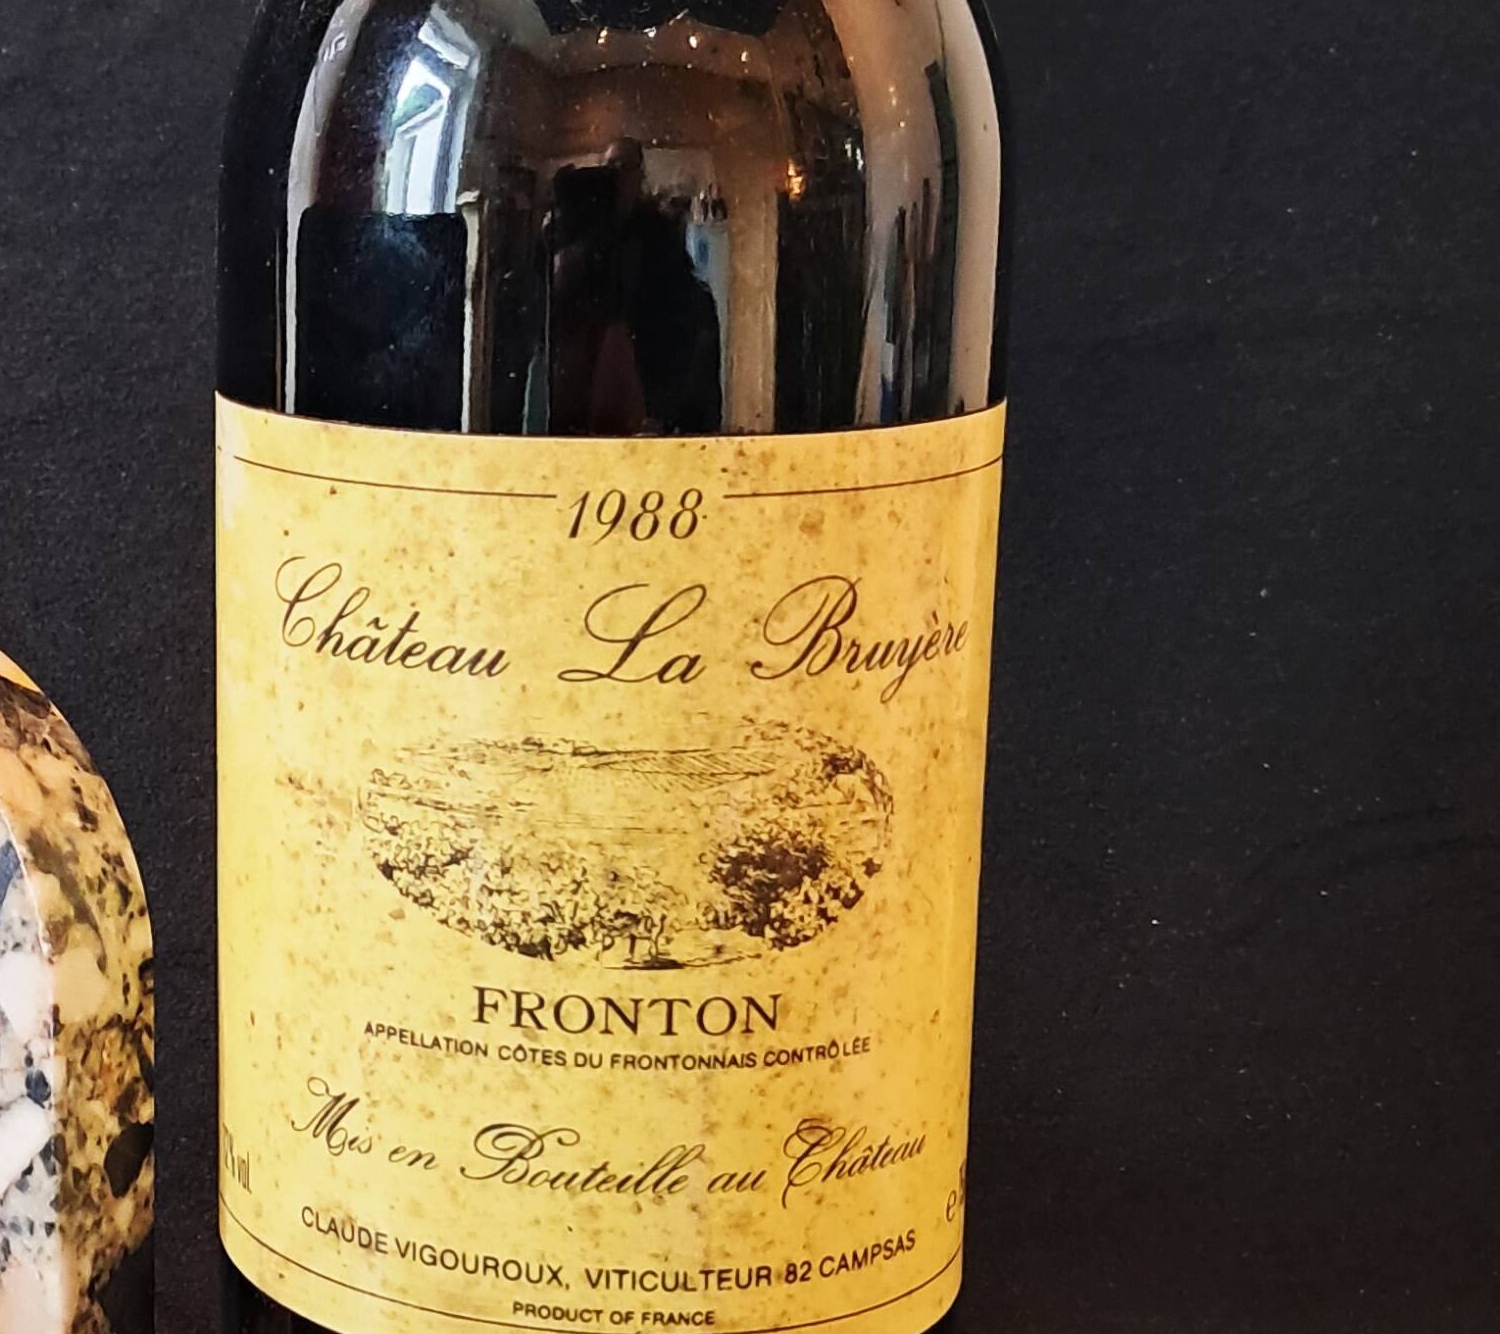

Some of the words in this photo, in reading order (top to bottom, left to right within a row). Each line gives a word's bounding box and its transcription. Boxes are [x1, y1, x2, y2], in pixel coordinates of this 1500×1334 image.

[567, 488, 704, 547] 1988
[274, 555, 511, 678] Château
[556, 582, 707, 685] La
[749, 574, 969, 705] Bruyère
[471, 984, 783, 1037] FRONTON
[362, 1020, 489, 1058] APPELLATION
[498, 1043, 568, 1067] CÔTES
[574, 1051, 604, 1069] DU
[609, 1051, 758, 1071] FRONTONNAIS
[290, 1076, 374, 1157] Mis
[387, 1143, 440, 1171] en
[459, 1122, 706, 1196] Bouteille
[706, 1168, 768, 1195] au
[781, 1117, 927, 1210] Château
[301, 1205, 390, 1255] CLAUDE
[394, 1236, 572, 1292] VIGOUROUX,
[584, 1265, 773, 1293] VITICULTEUR
[783, 1261, 814, 1285] 82
[819, 1228, 917, 1279] CAMPSAS
[512, 1300, 604, 1324] PRODUCT
[608, 1310, 636, 1326] OF
[640, 1310, 717, 1327] FRANCE
